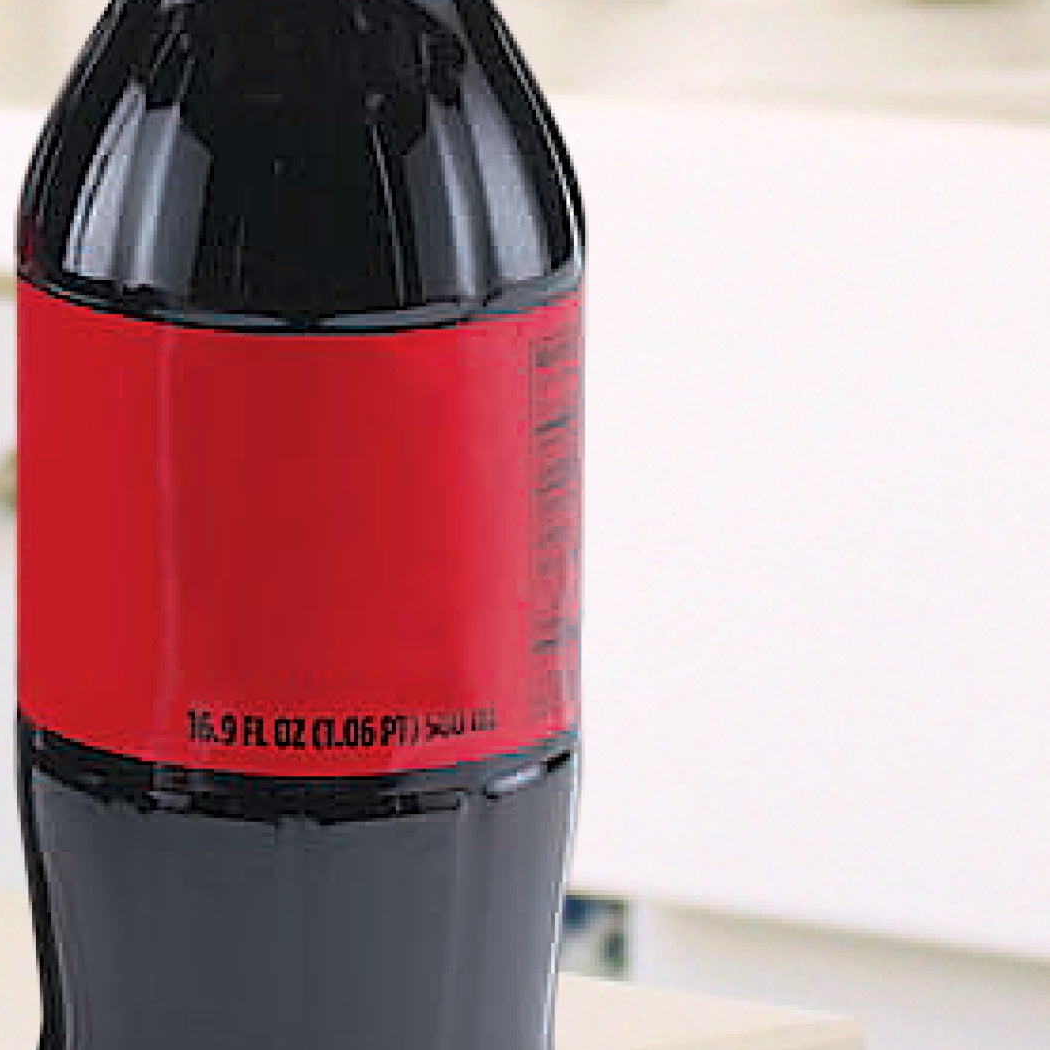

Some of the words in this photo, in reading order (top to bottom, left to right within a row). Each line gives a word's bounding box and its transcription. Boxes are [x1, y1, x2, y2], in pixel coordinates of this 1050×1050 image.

[188, 709, 236, 745] 16.9
[244, 716, 268, 747] FL
[274, 717, 305, 748] OZ
[312, 717, 374, 748] (1.06
